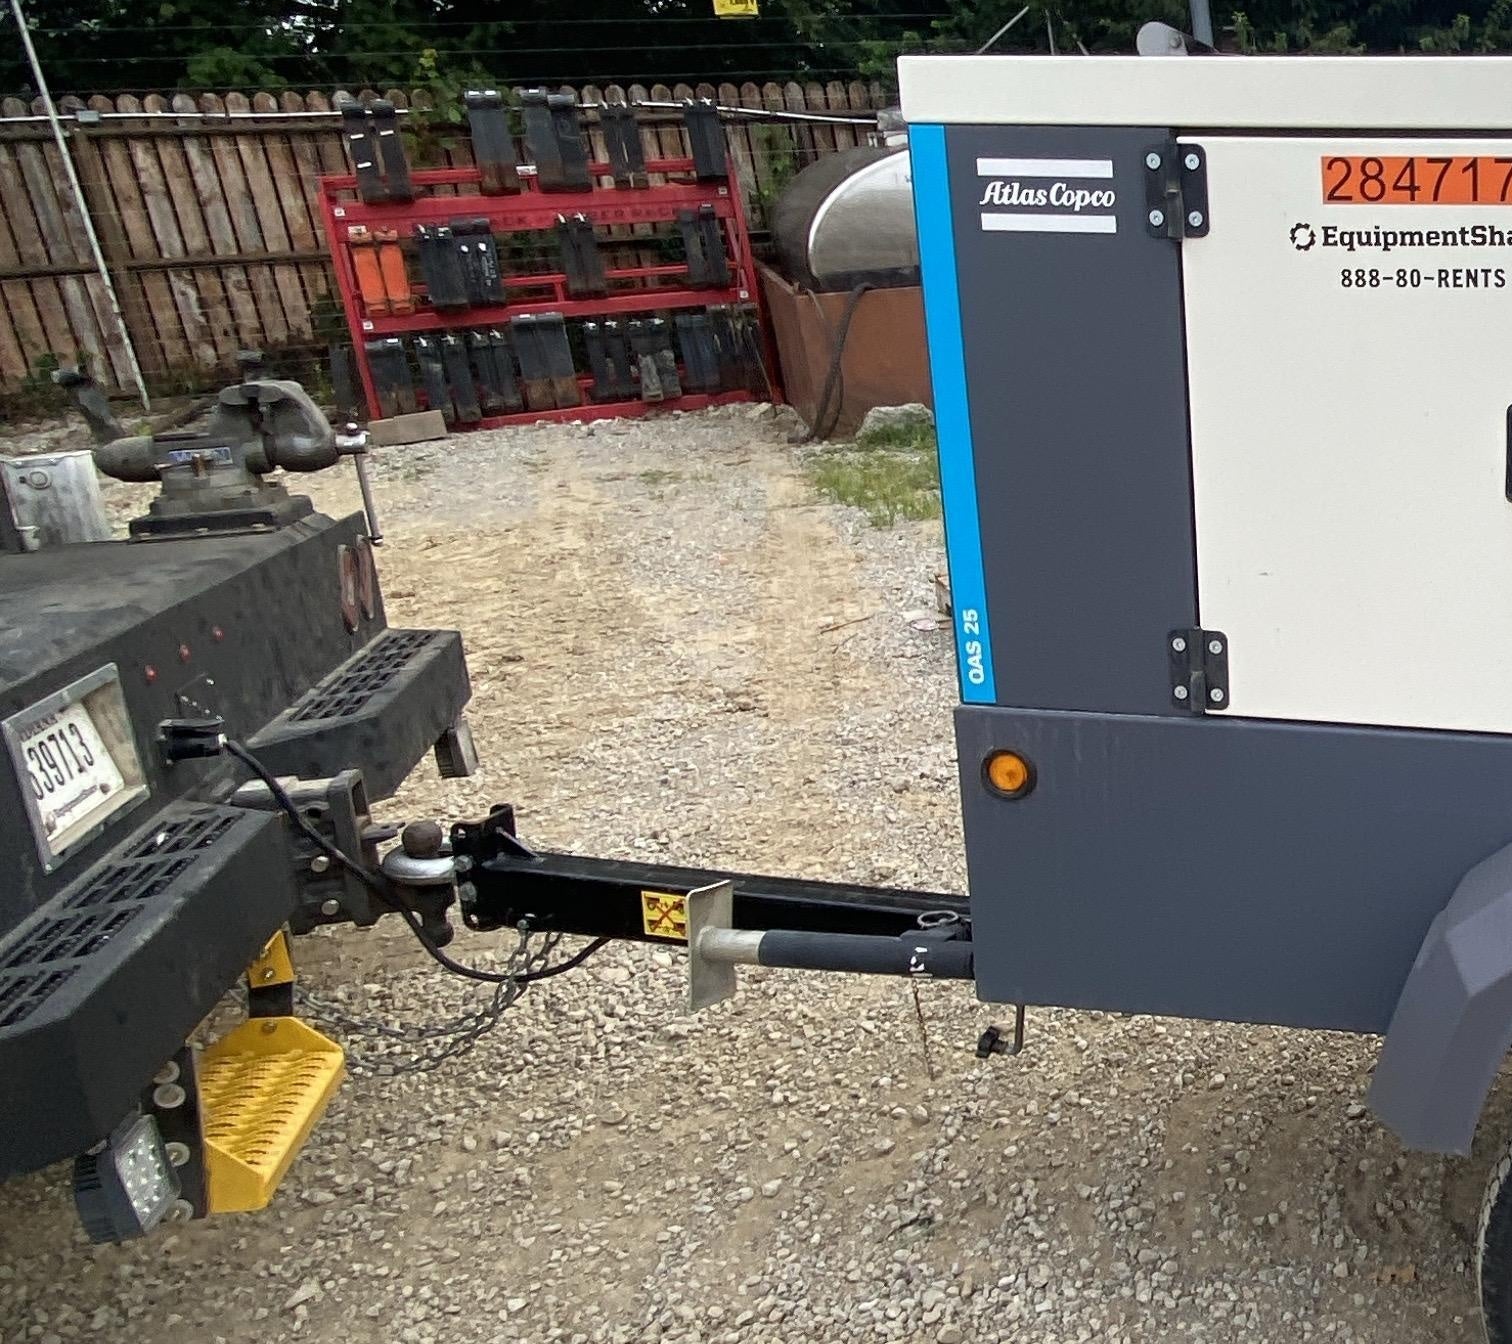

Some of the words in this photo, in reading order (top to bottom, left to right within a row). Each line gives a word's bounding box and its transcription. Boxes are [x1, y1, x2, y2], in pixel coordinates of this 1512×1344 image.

[1340, 268, 1507, 288] 888-80-RENTS
[962, 608, 980, 636] 25
[965, 640, 985, 685] QAS
